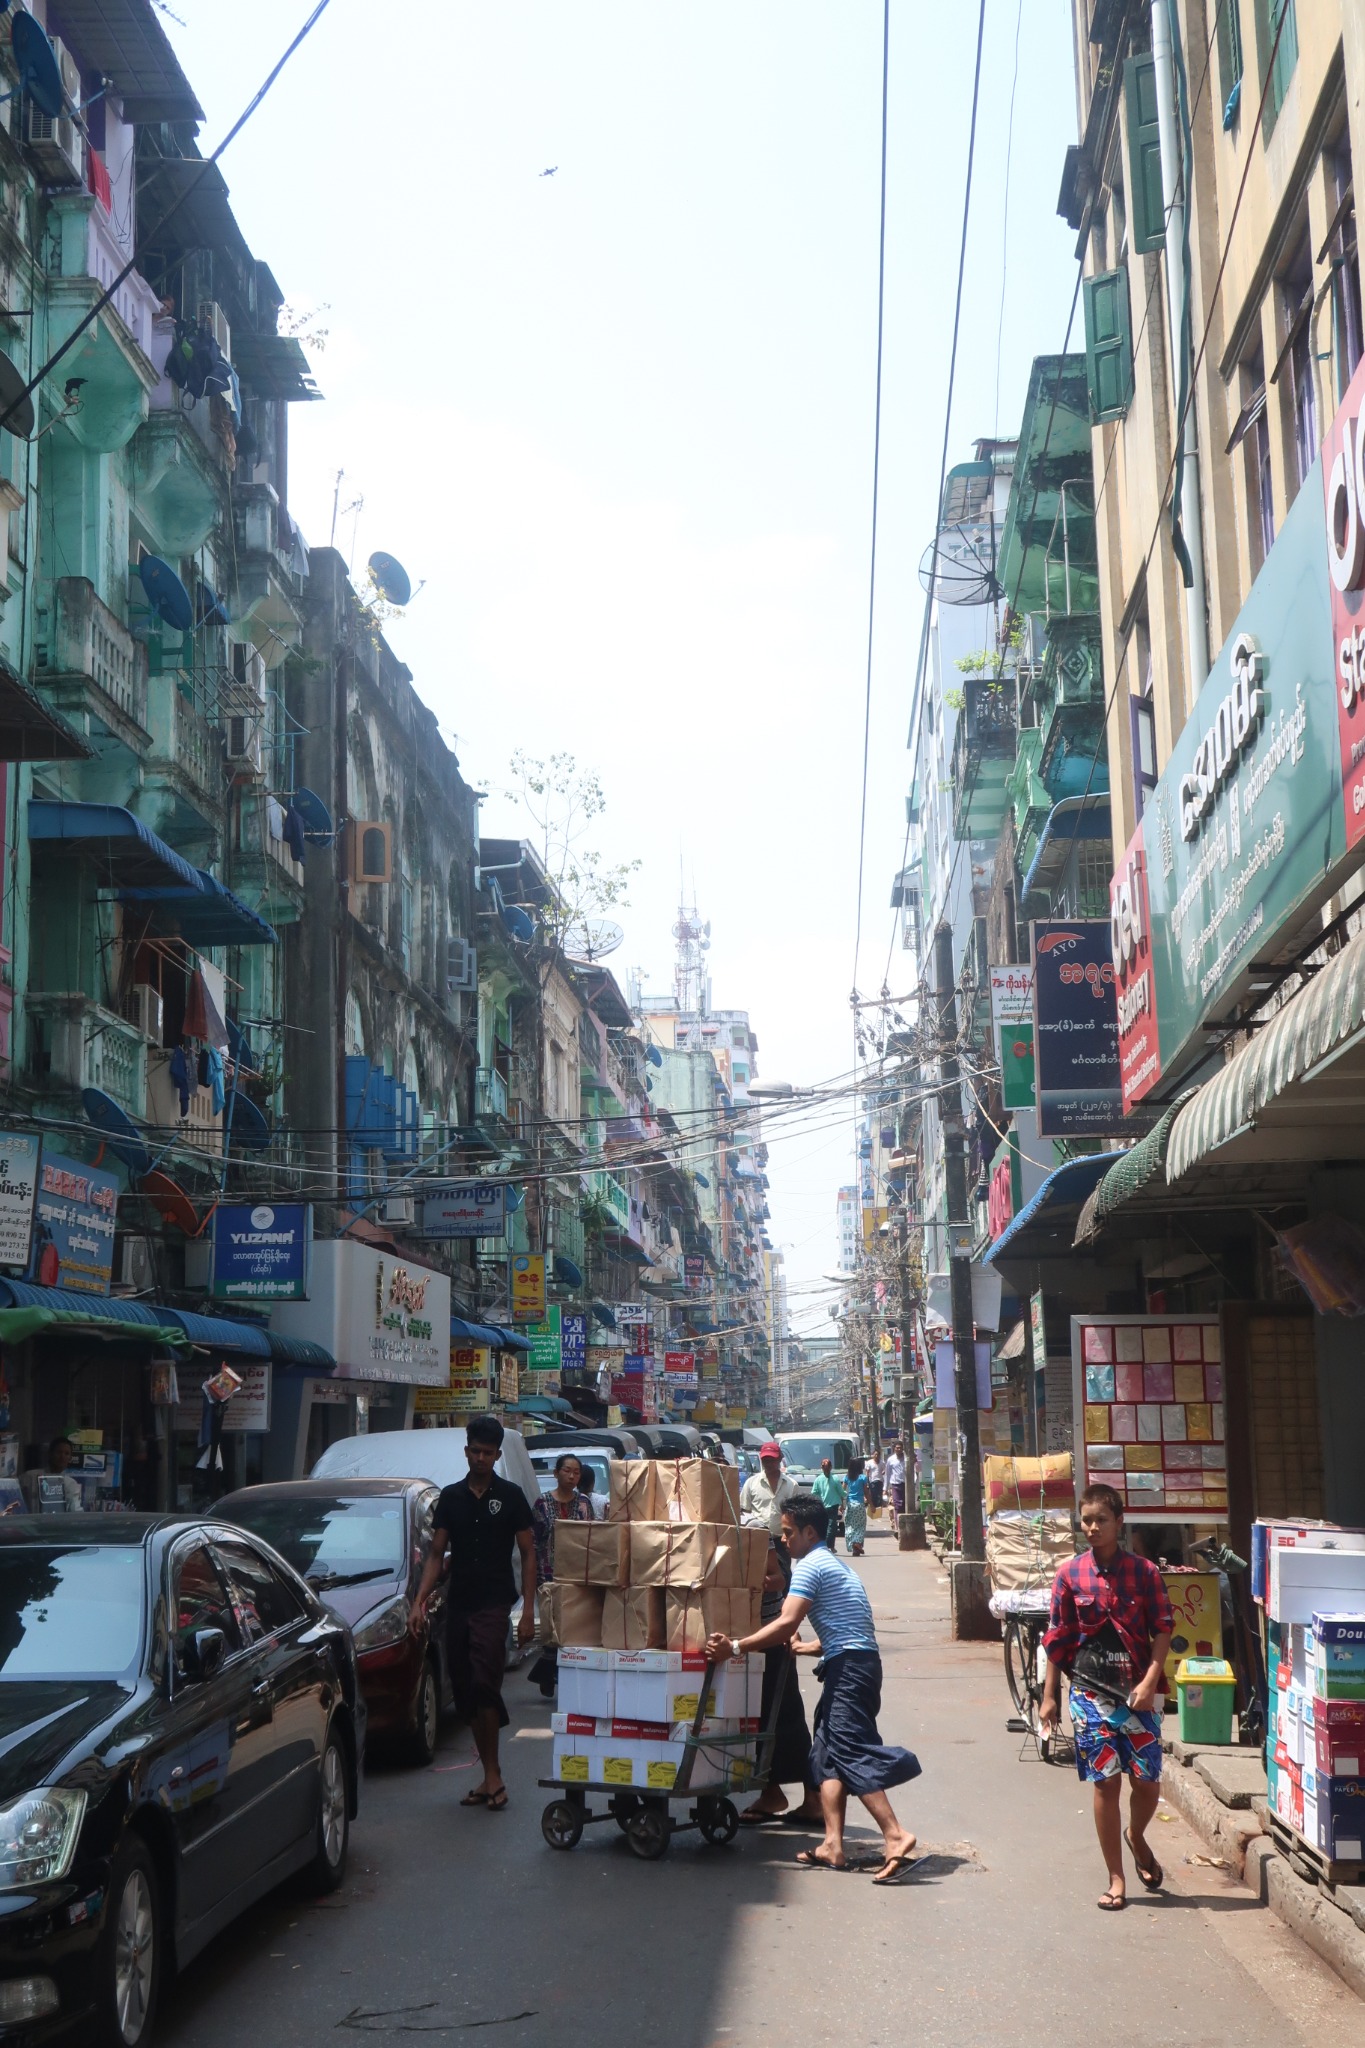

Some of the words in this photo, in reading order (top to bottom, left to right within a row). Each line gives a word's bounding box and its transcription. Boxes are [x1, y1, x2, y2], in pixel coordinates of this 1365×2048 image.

[1111, 850, 1147, 976] deli
[1052, 940, 1077, 957] AYO
[231, 1232, 294, 1245] YUZANA
[562, 1359, 583, 1367] TIGER
[1337, 1628, 1365, 1639] Dou
